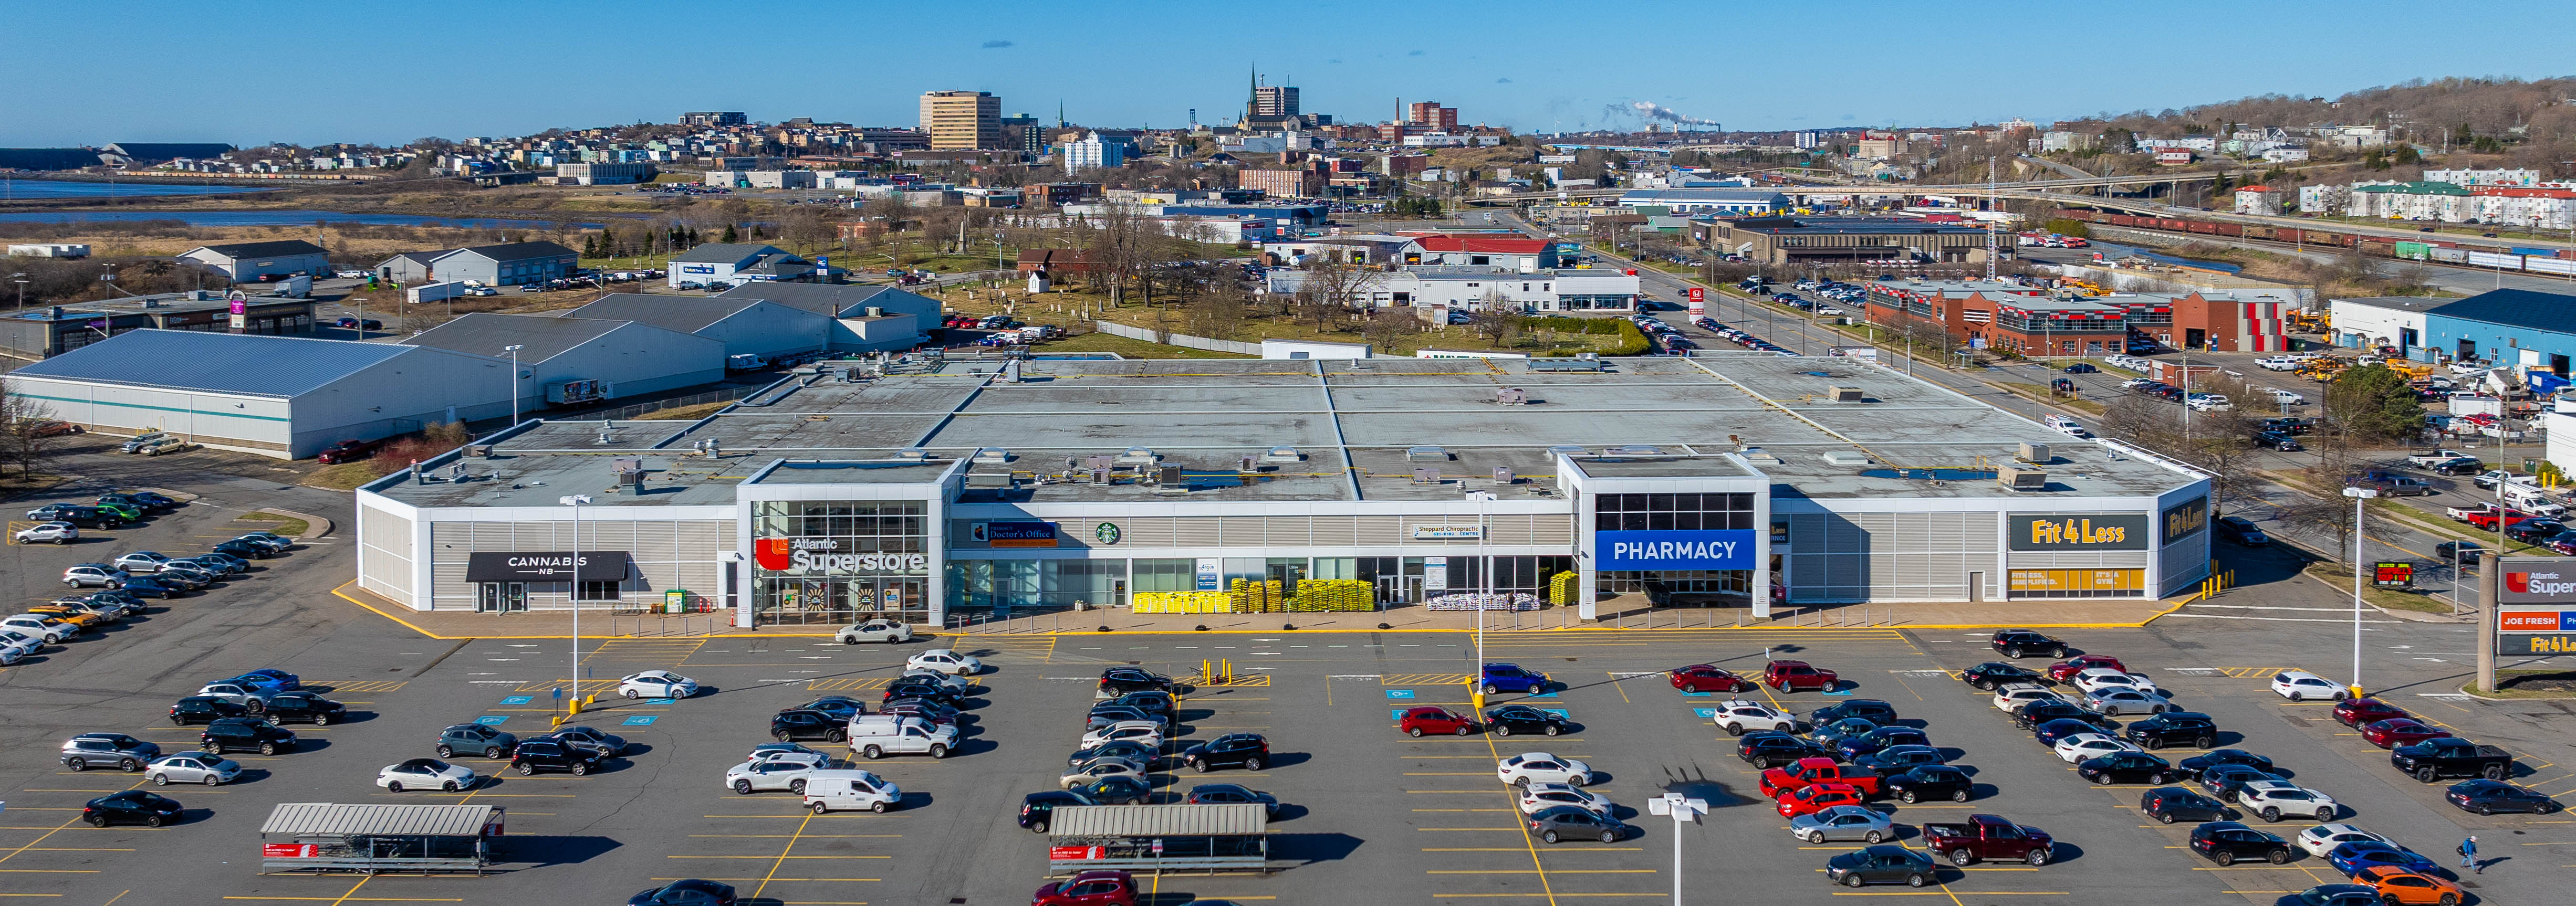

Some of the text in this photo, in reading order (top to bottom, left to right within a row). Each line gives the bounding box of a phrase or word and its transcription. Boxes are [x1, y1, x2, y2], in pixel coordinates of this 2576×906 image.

[2032, 519, 2125, 544] Fit 4 Less
[2170, 507, 2203, 537] Fit 4 Less
[791, 539, 838, 550] Atlantic
[1614, 541, 1737, 560] PHARMACY
[793, 550, 925, 575] Superstore
[2530, 580, 2576, 597] Super
[2531, 637, 2549, 652] Fit
[2550, 637, 2560, 652] 4
